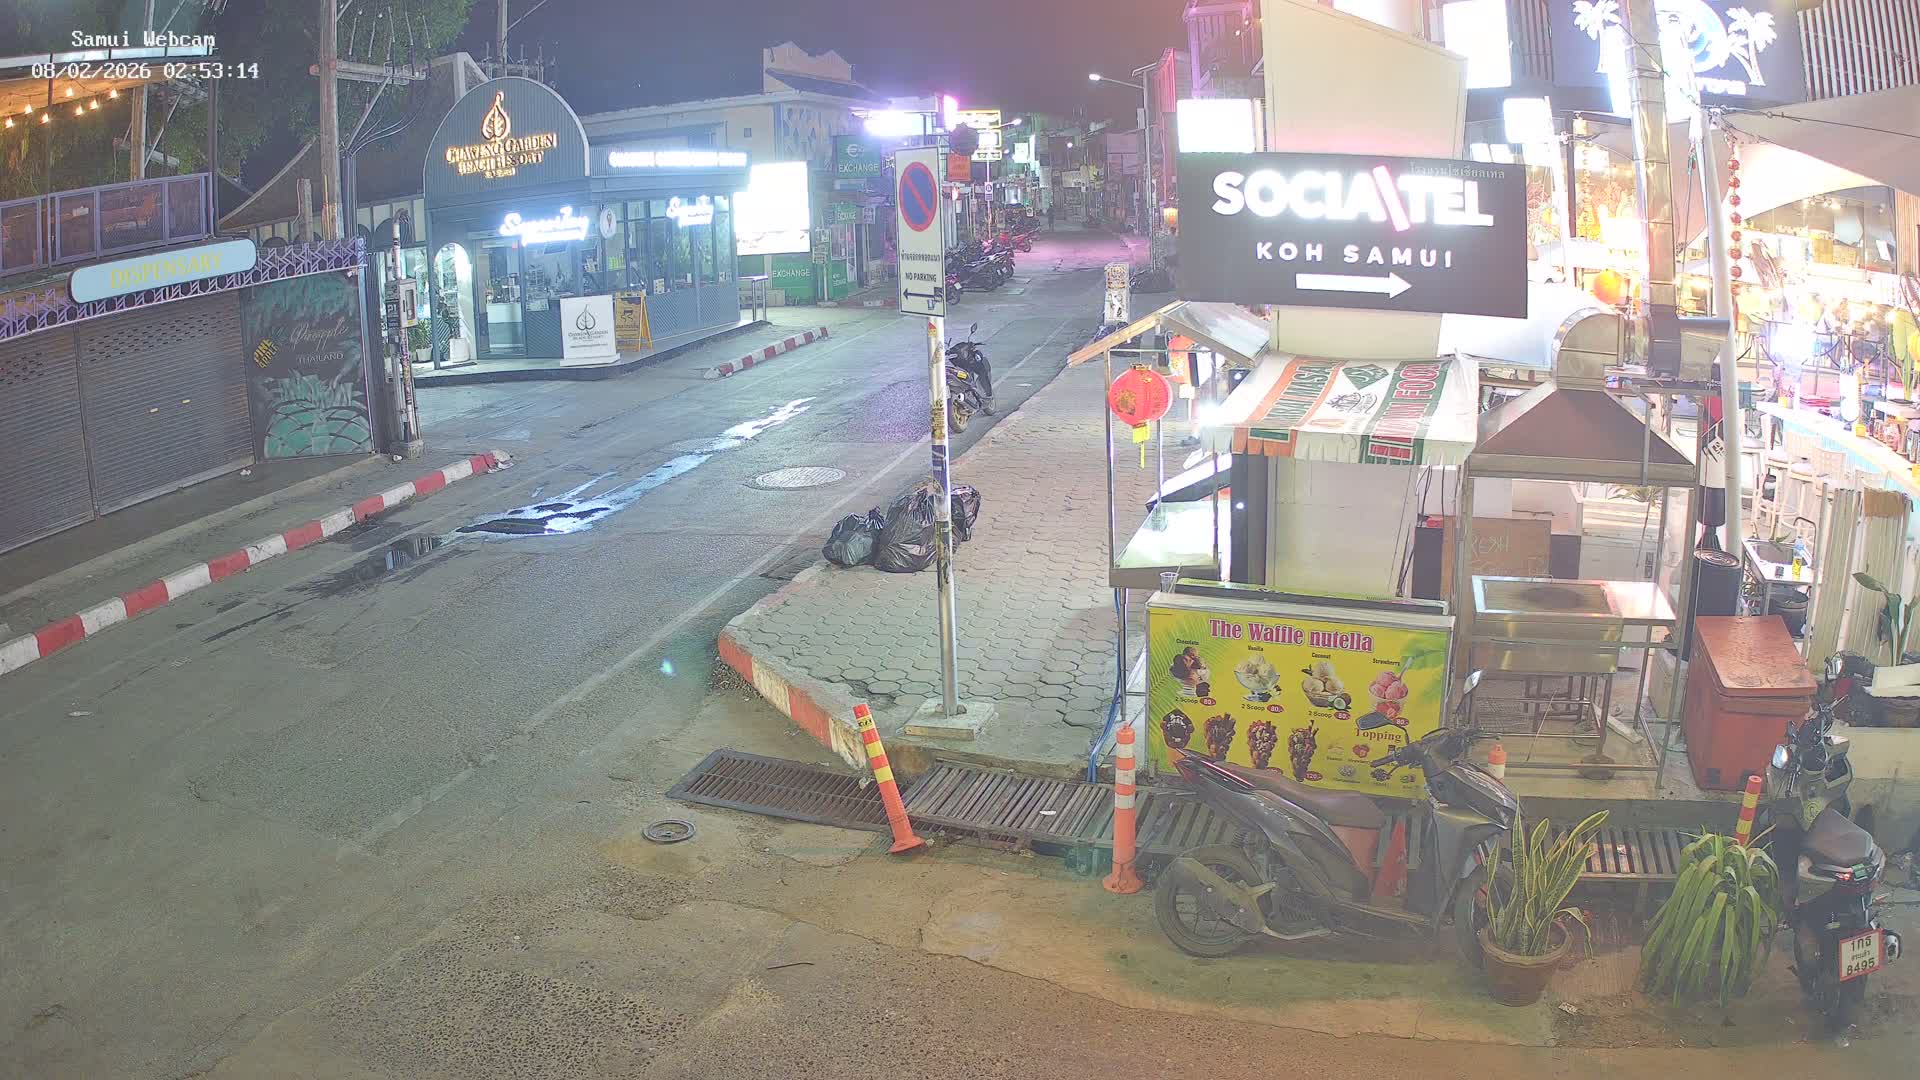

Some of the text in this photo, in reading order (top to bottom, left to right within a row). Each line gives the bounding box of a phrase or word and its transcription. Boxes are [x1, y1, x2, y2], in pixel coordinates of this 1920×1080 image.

[839, 163, 879, 173] EXCHANGE
[1256, 241, 1452, 268] KOH SAMUI
[110, 252, 223, 289] DISPENSARY
[772, 268, 811, 278] EXCHANGE
[905, 272, 937, 283] NO PARKING
[296, 352, 345, 365] THAILAND
[1209, 619, 1373, 652] The Waffle nutella
[1176, 638, 1199, 646] Chocolate
[1311, 652, 1331, 660] Coconut
[1372, 658, 1400, 667] Strawberry
[1846, 957, 1875, 976] 8495
